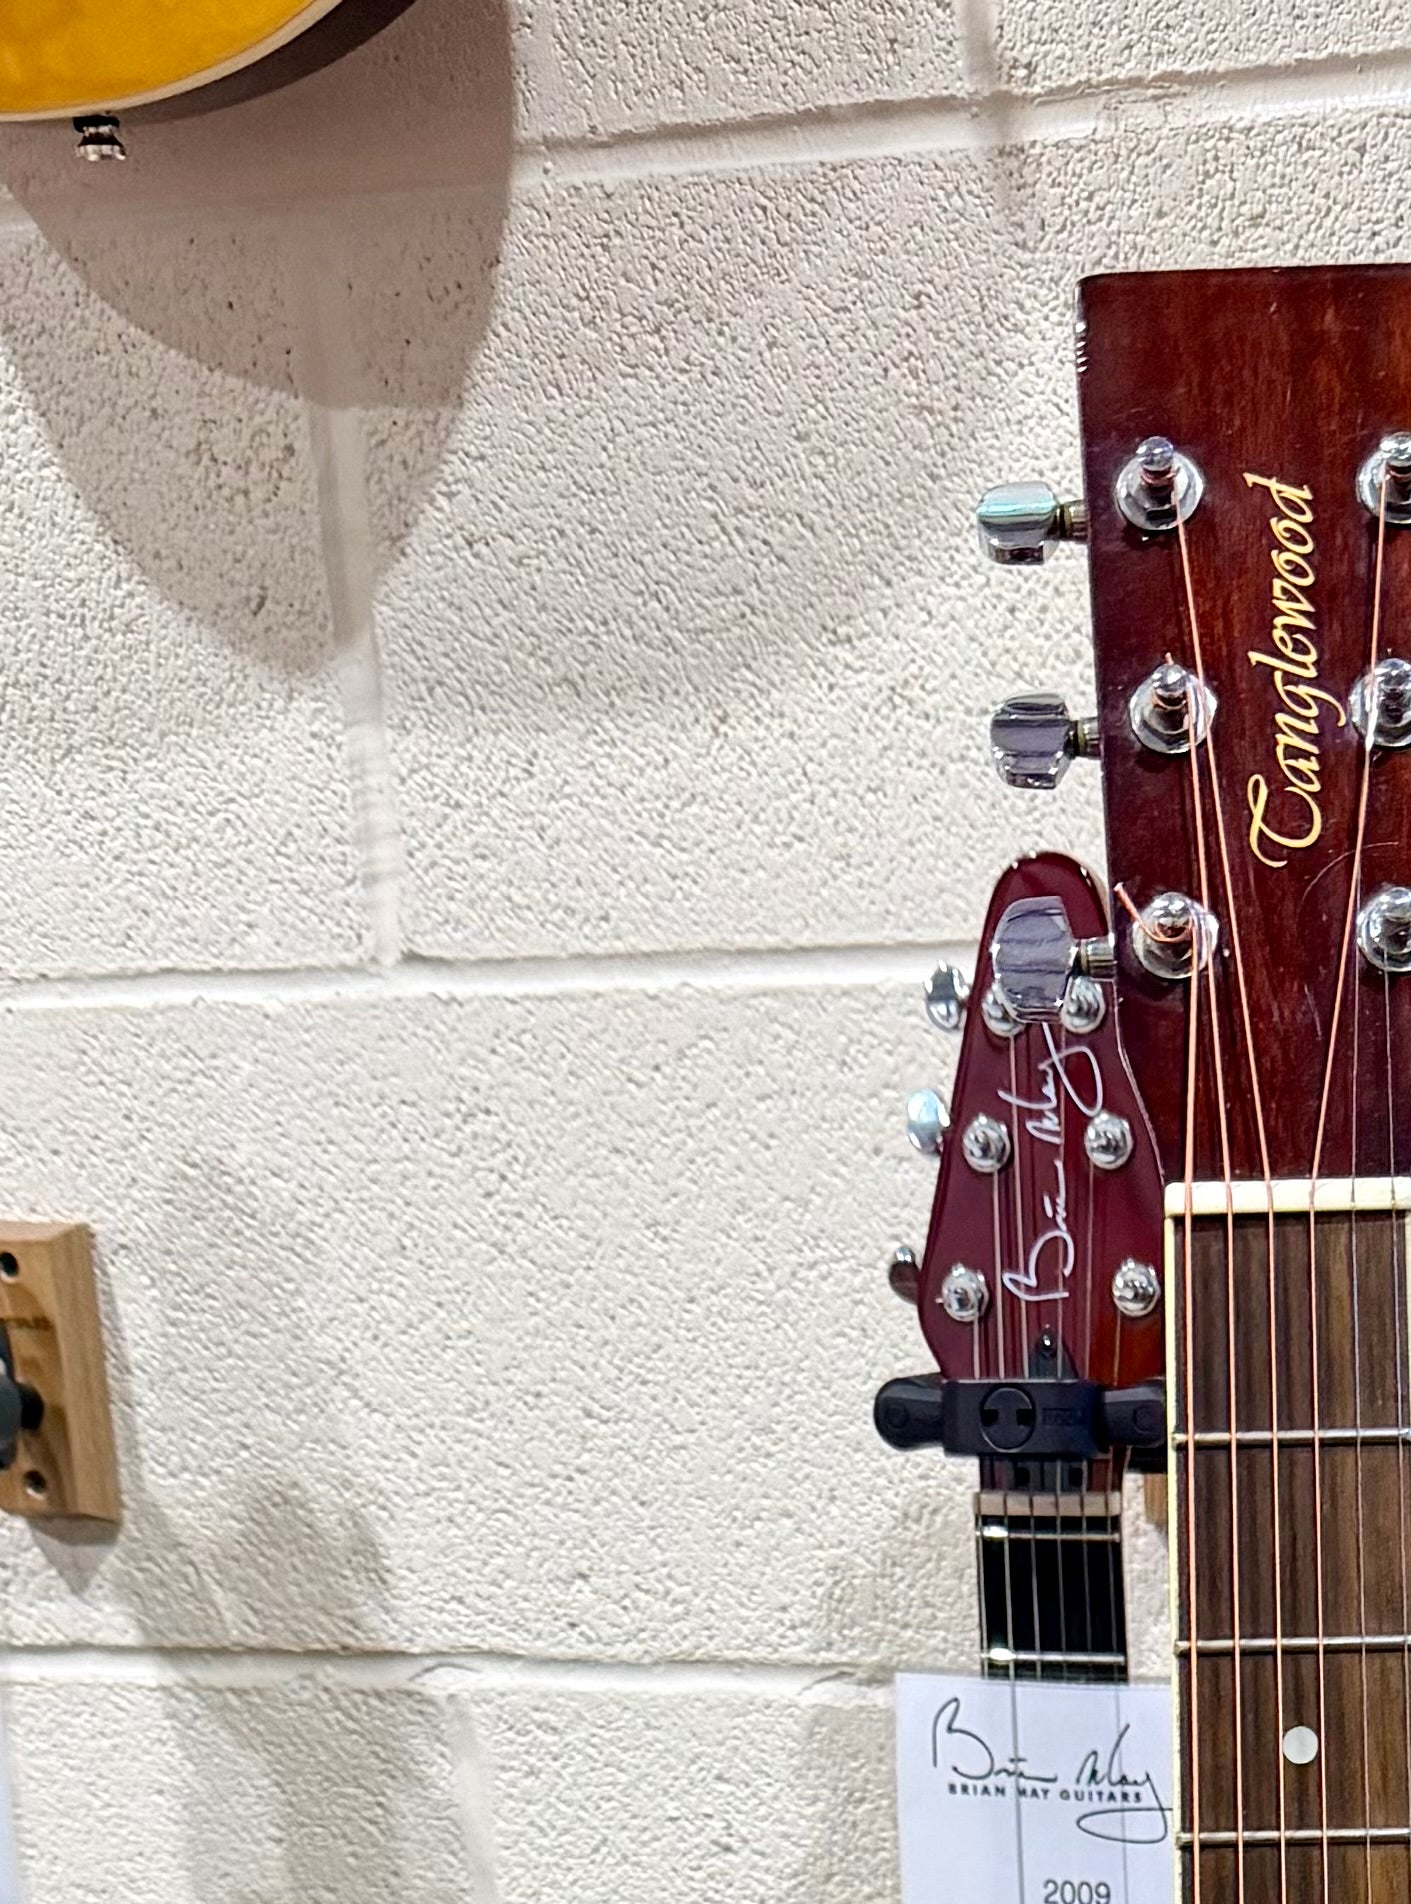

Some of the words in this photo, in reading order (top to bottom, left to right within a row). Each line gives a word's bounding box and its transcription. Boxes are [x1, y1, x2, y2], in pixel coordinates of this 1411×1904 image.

[1244, 472, 1350, 868] Tanglewood
[947, 1782, 1007, 1798] BRIAN
[1015, 1786, 1050, 1801] MAY
[1059, 1788, 1143, 1804] GUITARS
